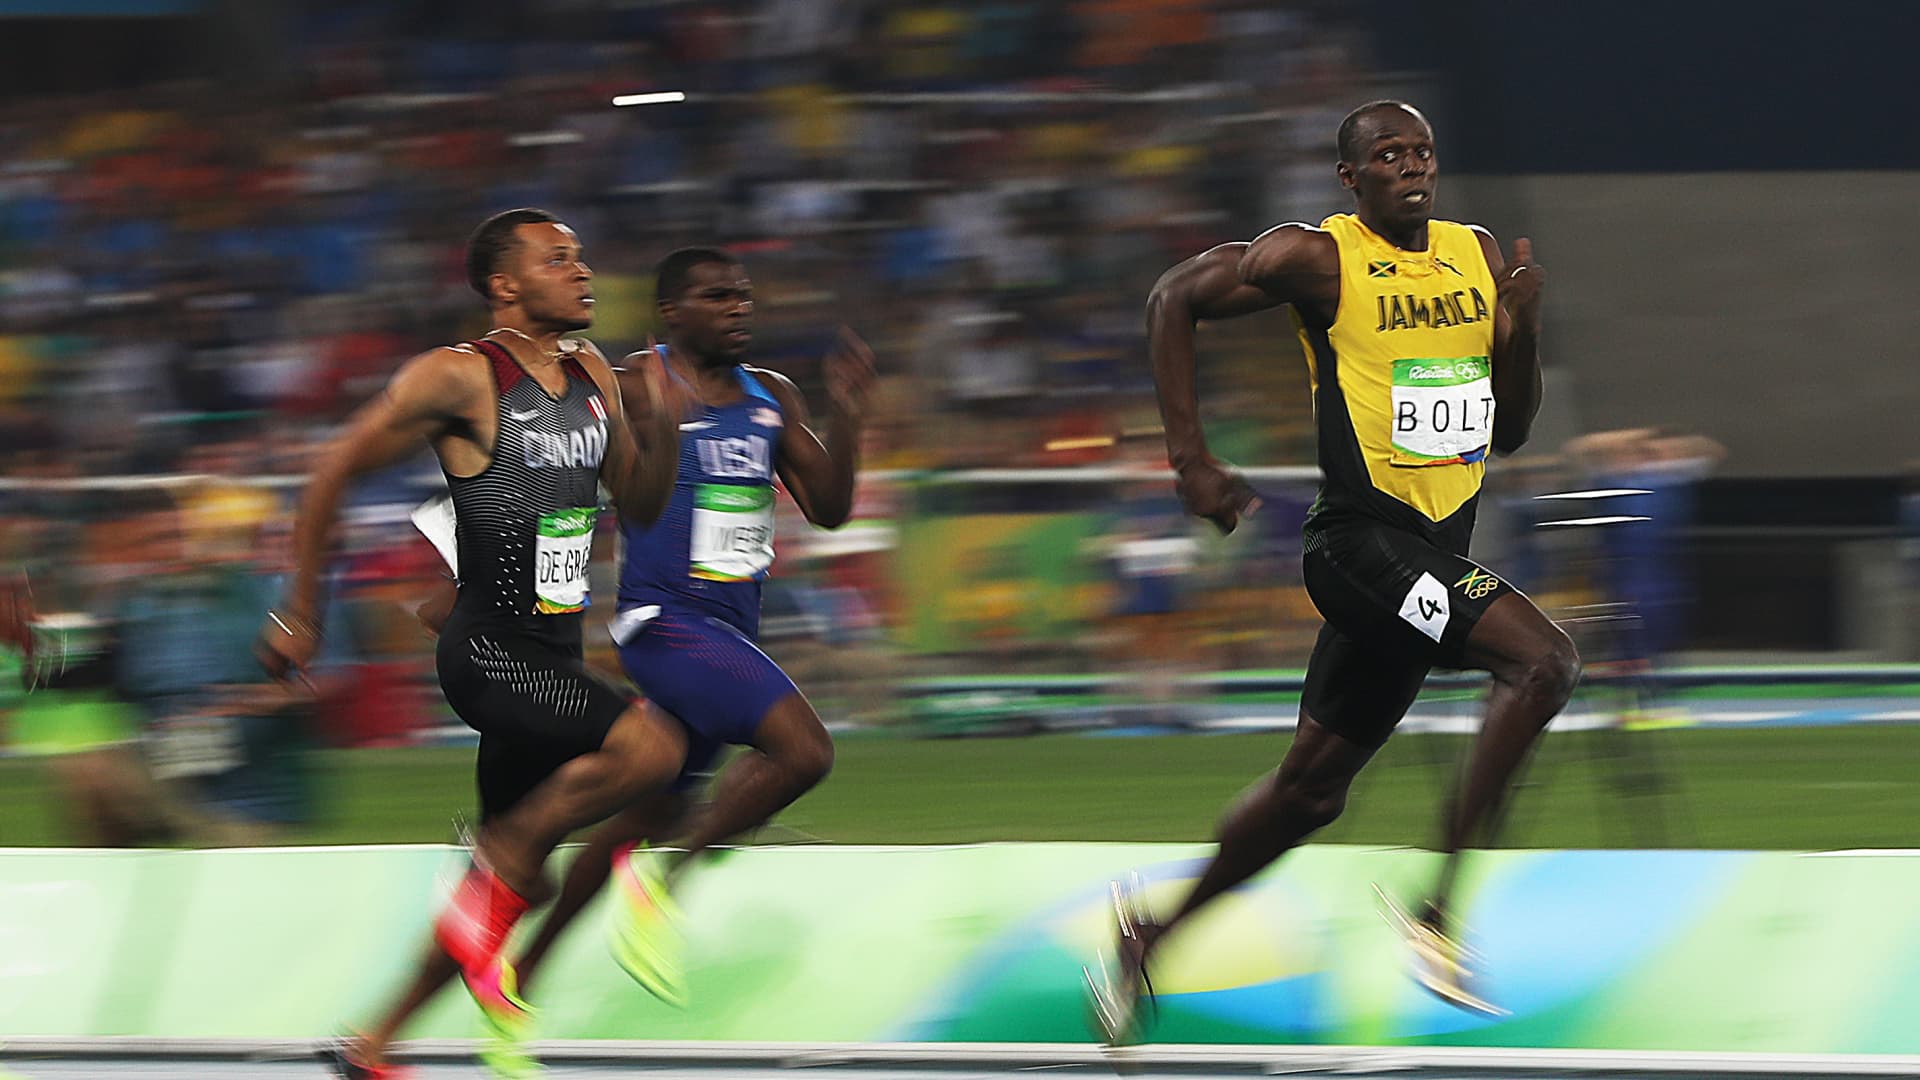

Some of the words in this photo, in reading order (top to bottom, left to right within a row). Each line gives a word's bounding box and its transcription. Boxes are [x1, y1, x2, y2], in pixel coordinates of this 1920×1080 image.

[1376, 287, 1491, 332] JAMAICA
[1397, 397, 1493, 433] BOLT
[696, 435, 770, 479] USA
[540, 550, 562, 583] DE
[1418, 596, 1443, 622] 4
